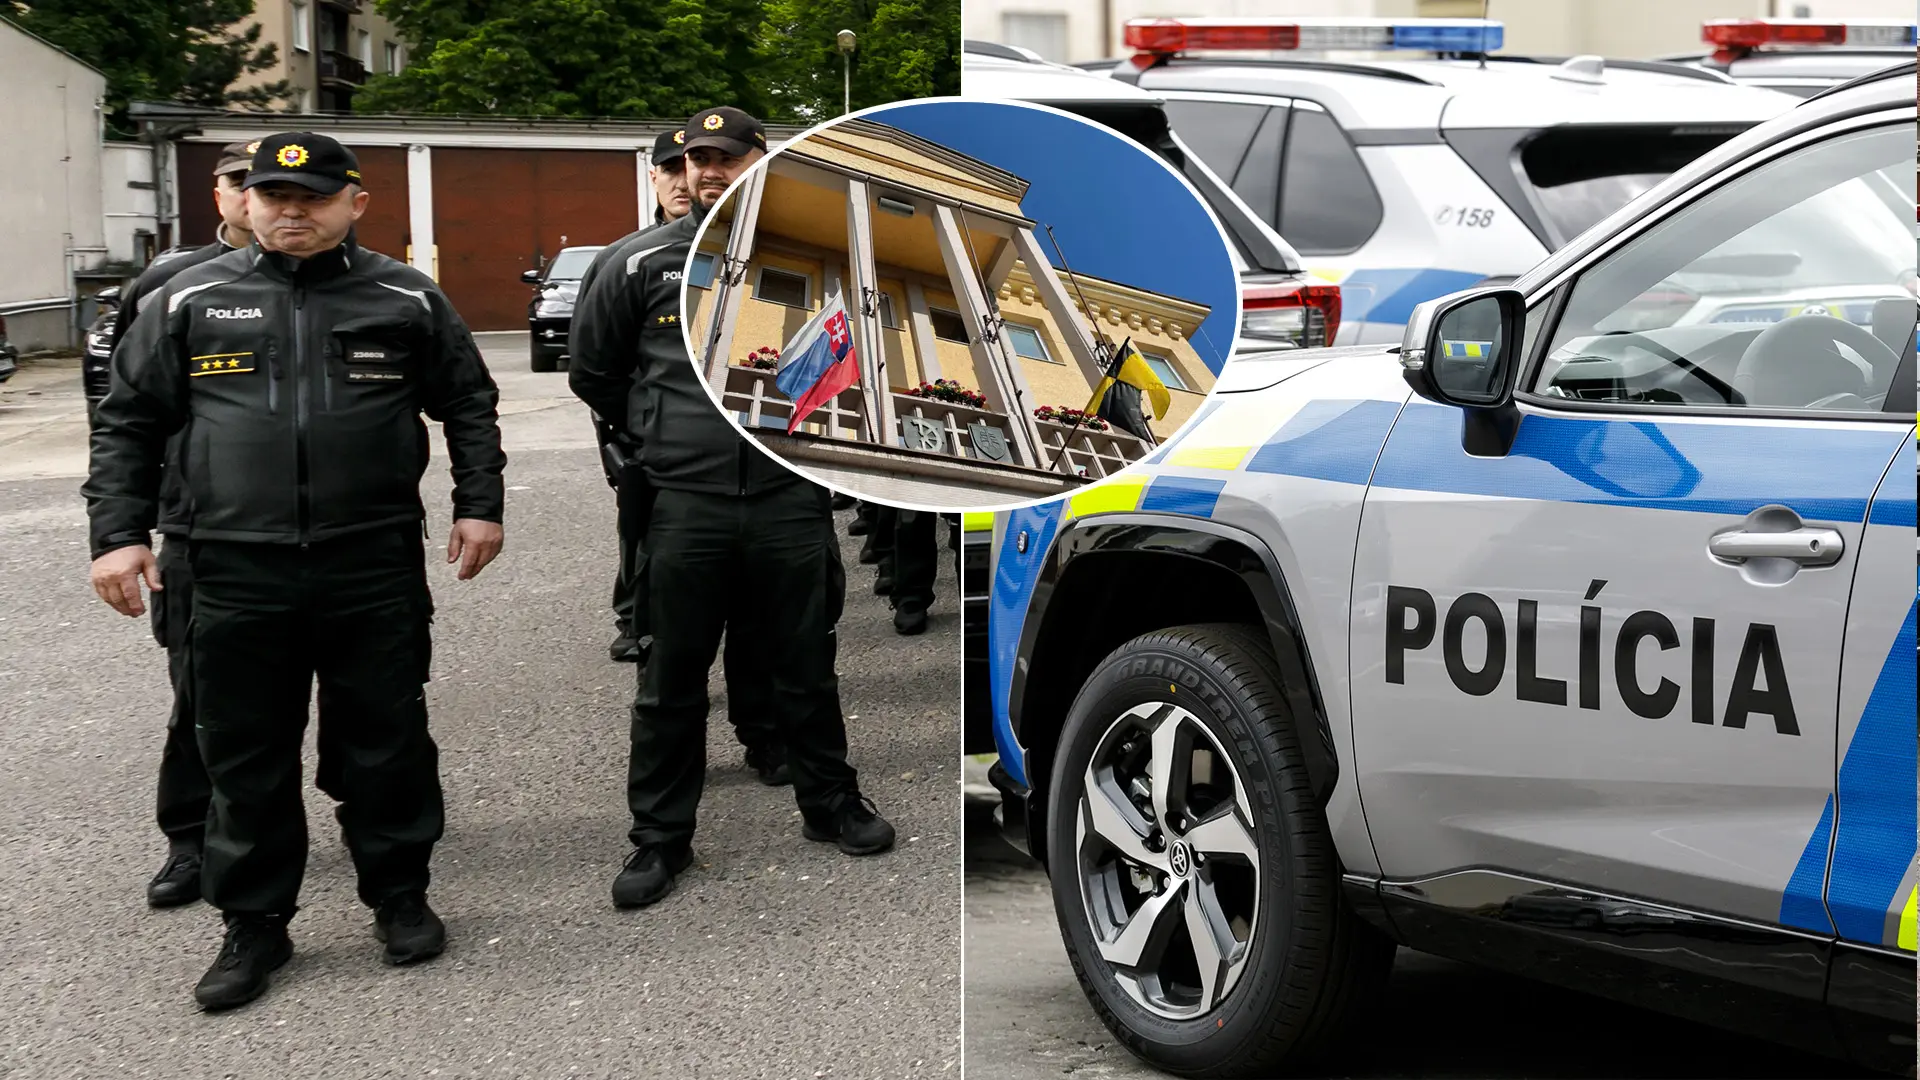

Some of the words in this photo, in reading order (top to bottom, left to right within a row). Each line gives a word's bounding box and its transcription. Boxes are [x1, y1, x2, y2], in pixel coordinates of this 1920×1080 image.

[1457, 207, 1494, 228] 158
[206, 306, 263, 319] POLÍCIA
[1386, 579, 1801, 737] POLÍCIA
[1114, 657, 1260, 767] GRANDTREK
